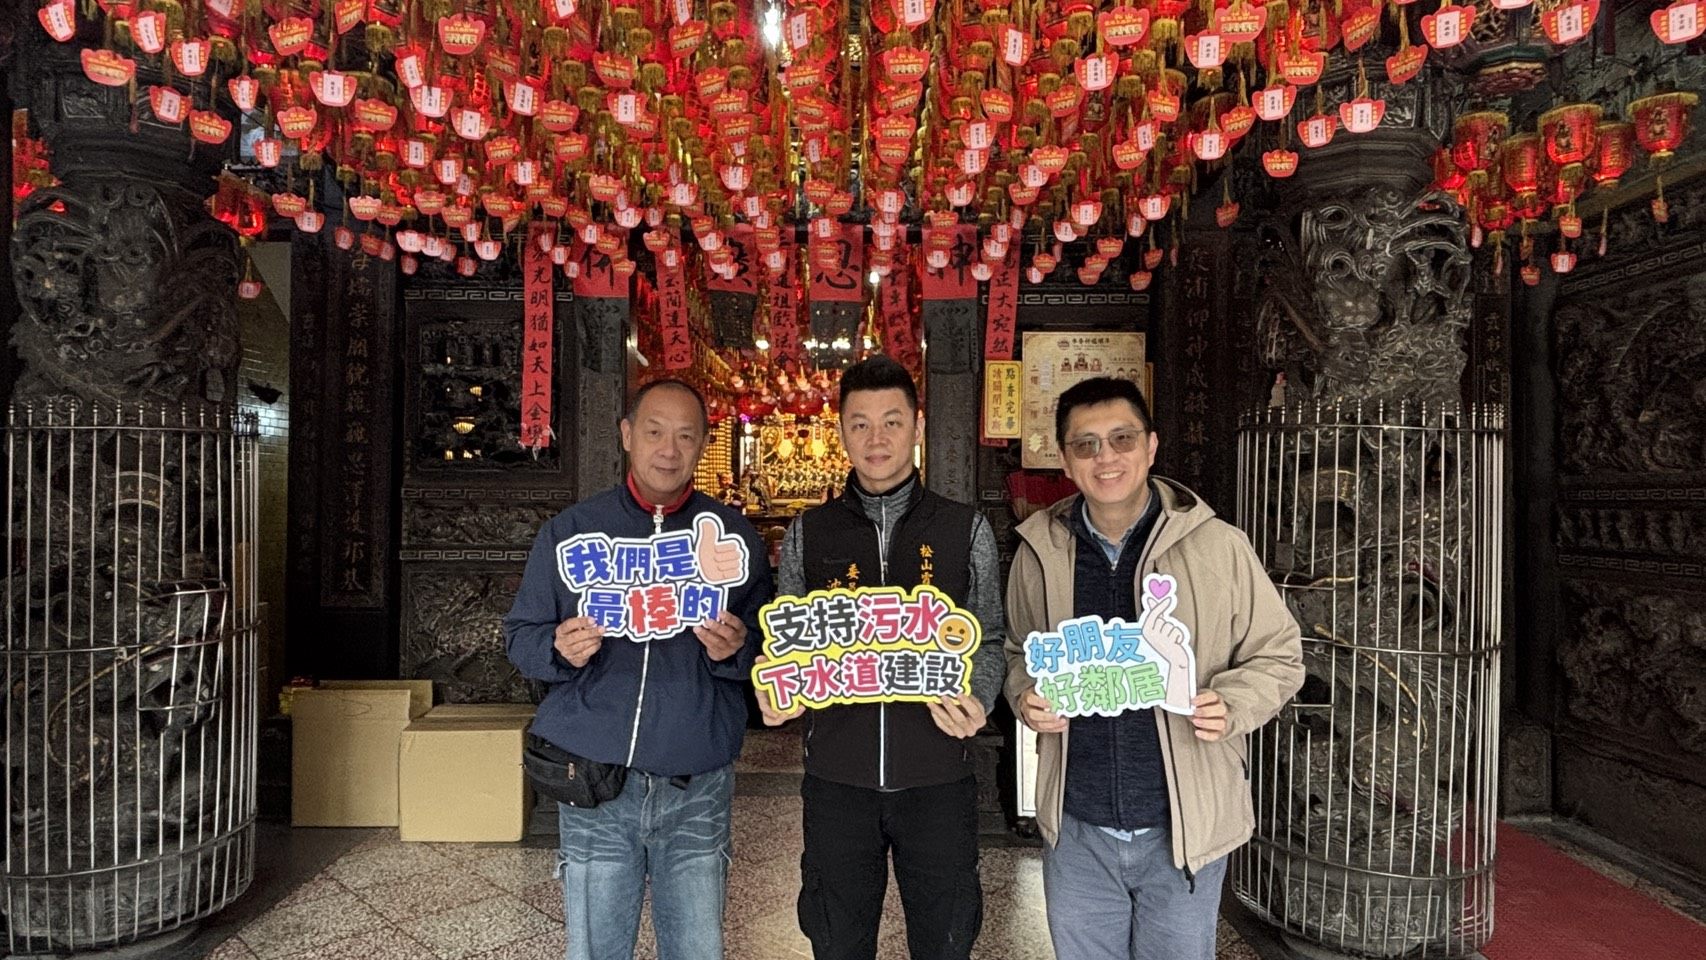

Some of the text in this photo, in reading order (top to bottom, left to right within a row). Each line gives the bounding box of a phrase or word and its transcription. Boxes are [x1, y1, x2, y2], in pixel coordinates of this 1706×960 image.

[563, 537, 699, 585] 我們是
[584, 586, 722, 635] 最棒的
[768, 594, 946, 653] 支持污水
[1028, 621, 1146, 673] 好朋友
[762, 650, 964, 709] 下水道建設
[1041, 661, 1167, 713] 好鄰居
